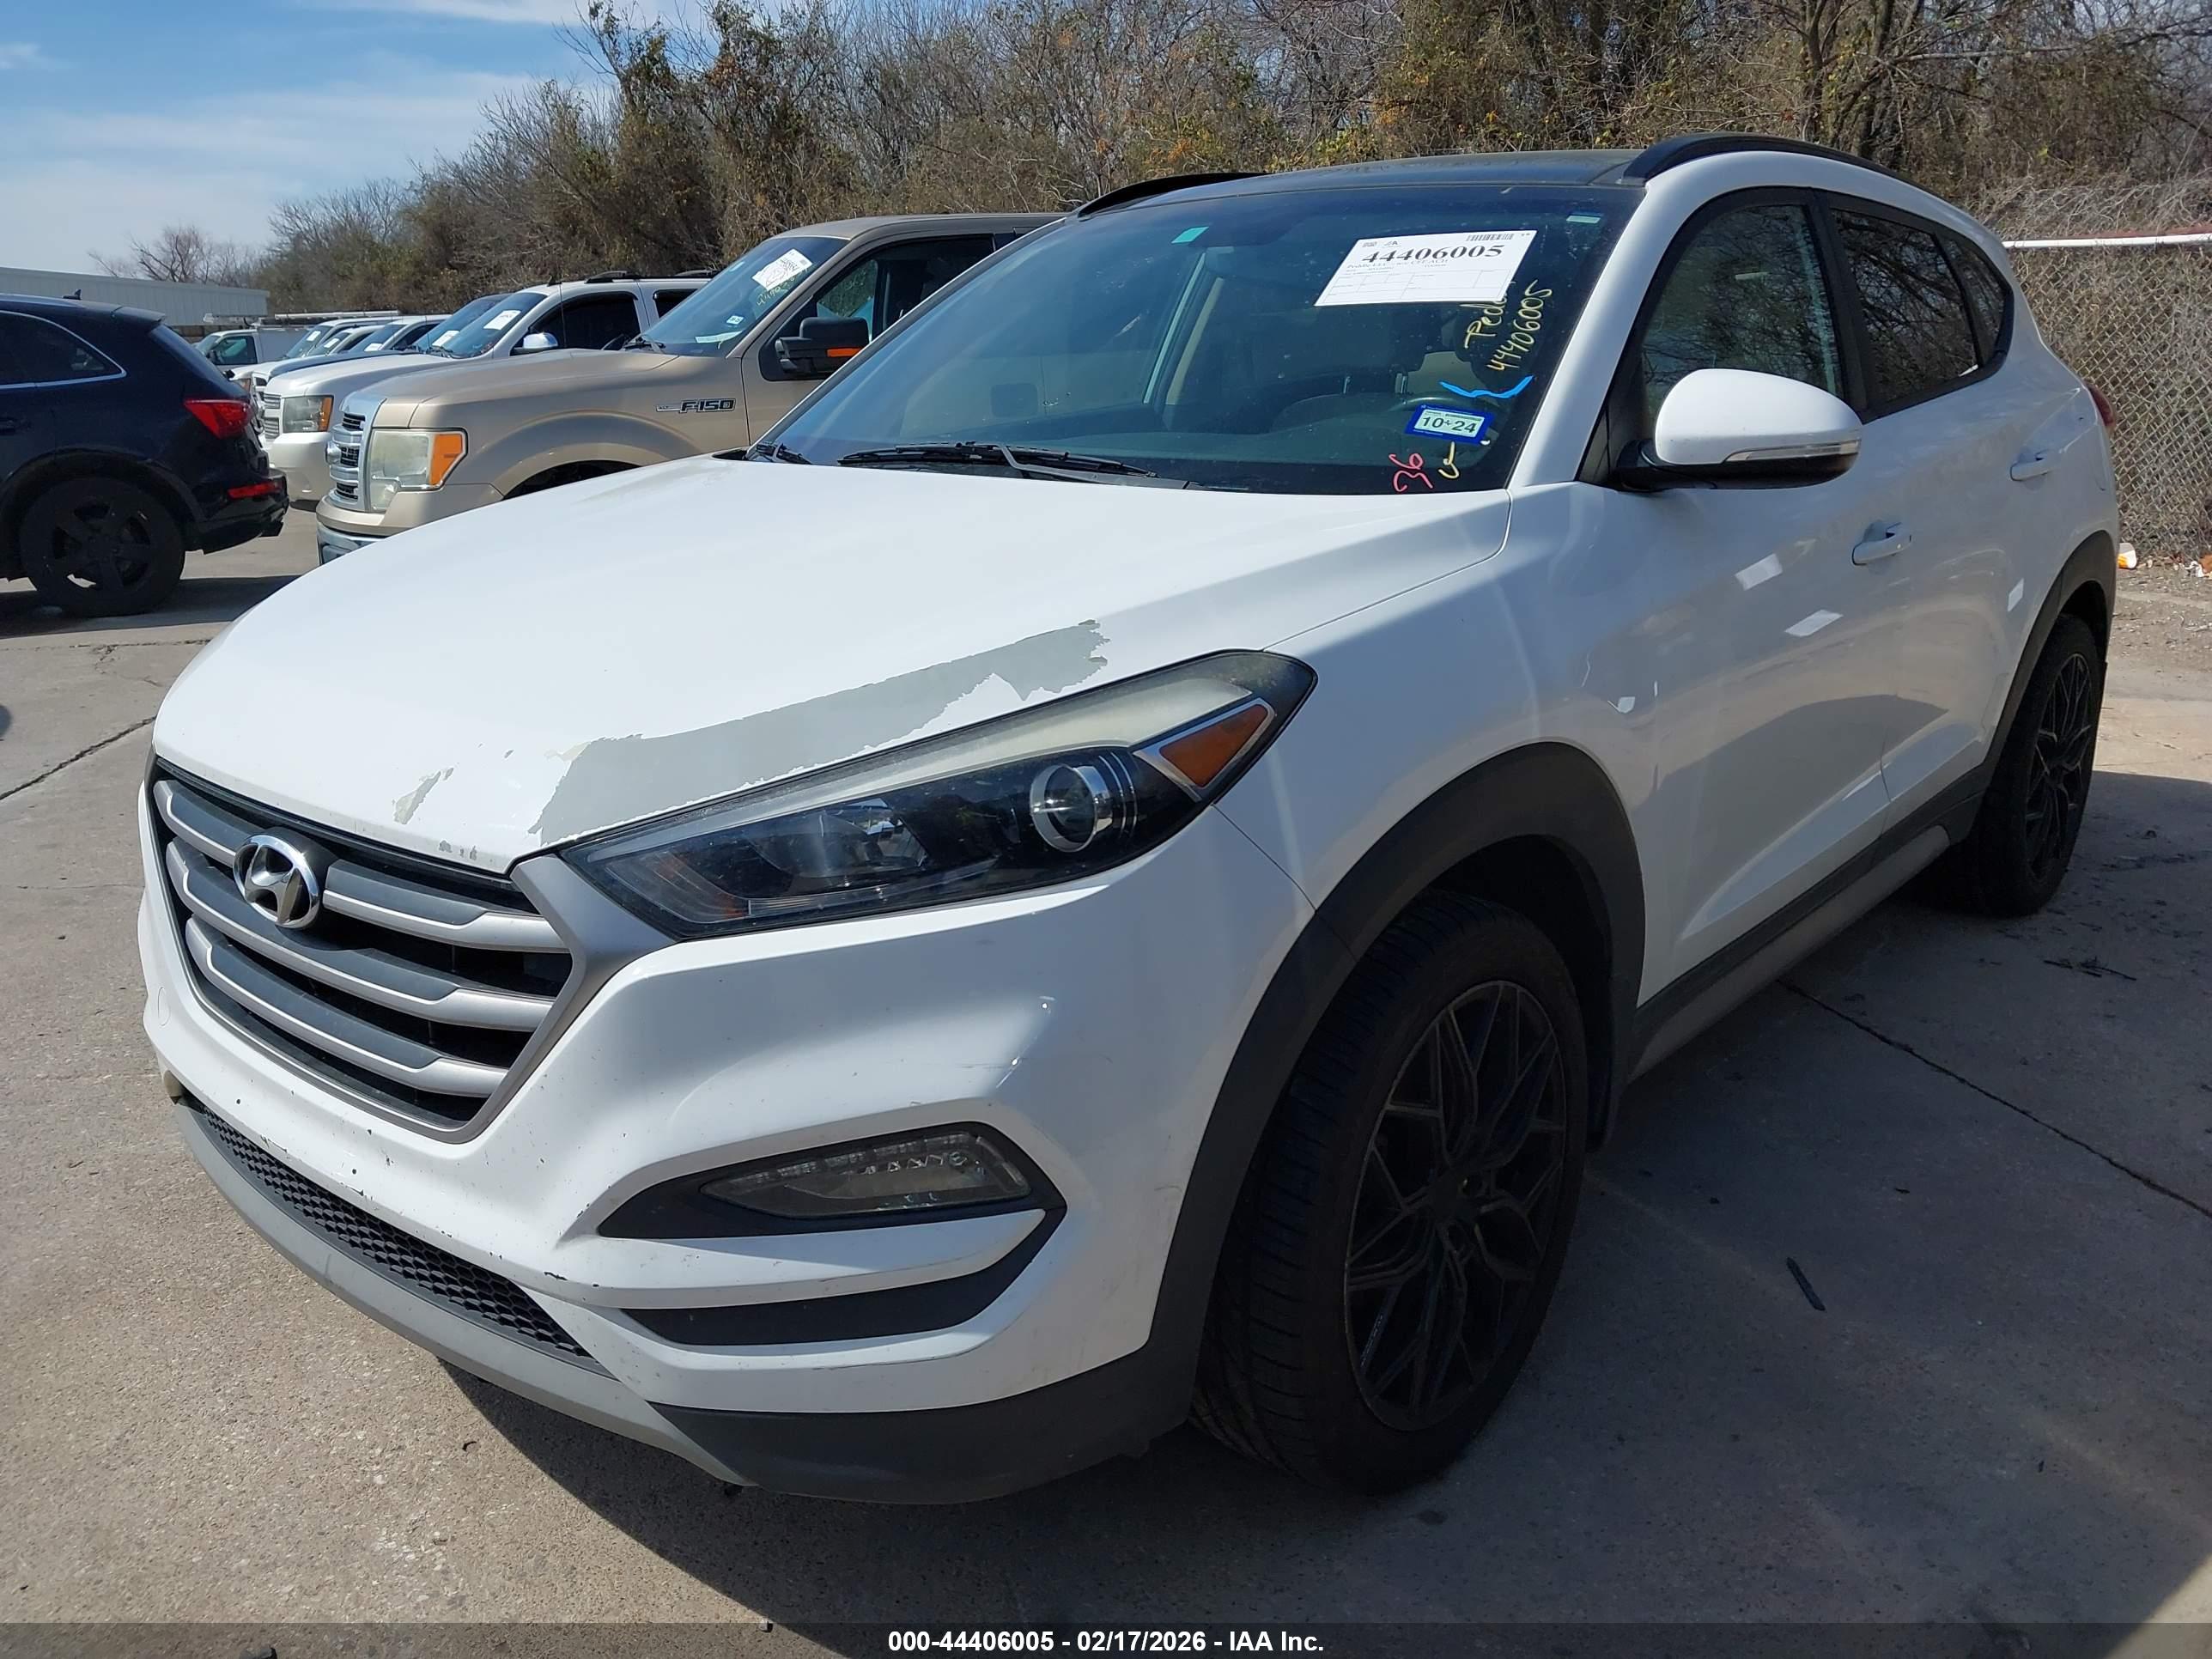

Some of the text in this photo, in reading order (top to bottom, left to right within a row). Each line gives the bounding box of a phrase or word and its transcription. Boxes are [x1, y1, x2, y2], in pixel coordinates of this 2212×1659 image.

[1362, 245, 1504, 263] 44406005
[1486, 279, 1553, 371] 44406005
[680, 399, 735, 413] F-150
